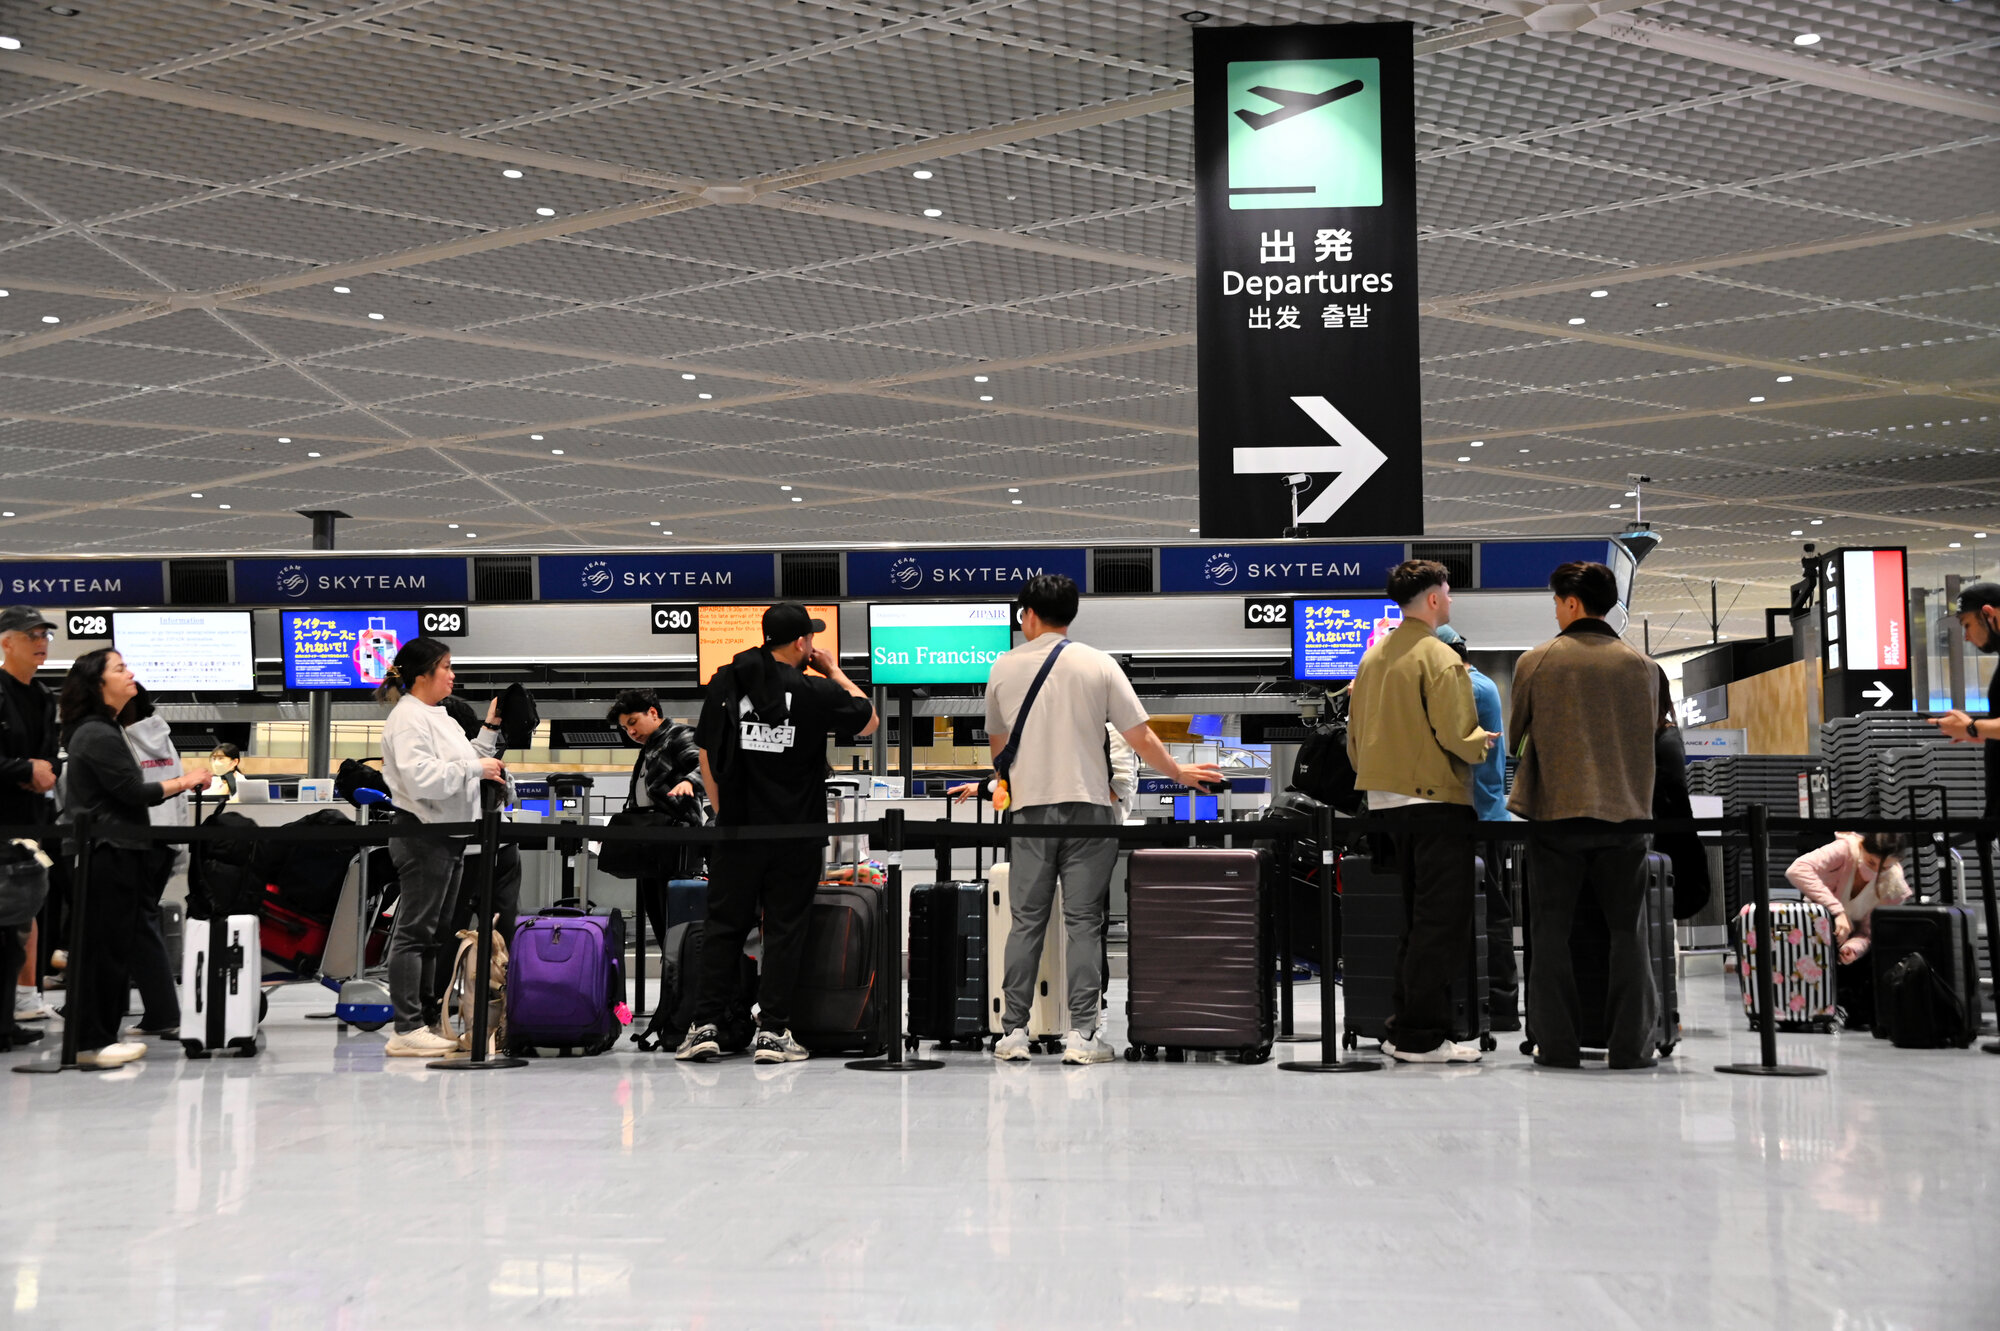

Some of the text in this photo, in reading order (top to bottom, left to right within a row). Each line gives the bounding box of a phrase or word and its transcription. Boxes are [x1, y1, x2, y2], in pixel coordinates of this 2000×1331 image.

[1260, 228, 1353, 264] 出発
[1223, 271, 1394, 302] Departures
[1249, 305, 1302, 330] 出发
[1320, 303, 1372, 329] 출발
[623, 571, 732, 586] SKYTEAM
[932, 567, 1043, 582] SKYTEAM
[1247, 562, 1361, 578] SKYTEAM
[12, 578, 122, 593] SKYTEAM
[318, 575, 426, 589] SKYTEAM
[654, 610, 692, 629] C30
[969, 609, 1006, 618] ZIPAIR
[1248, 604, 1287, 623] C32
[1304, 606, 1351, 618] ライターは
[69, 615, 107, 635] C28
[293, 617, 337, 629] ライターは
[424, 613, 461, 633] C29
[1305, 618, 1371, 630] スーツケースに
[294, 629, 356, 641] スーツケースに
[1890, 620, 1900, 665] PRIORITY
[874, 646, 910, 665] San
[740, 724, 793, 745] LARGE
